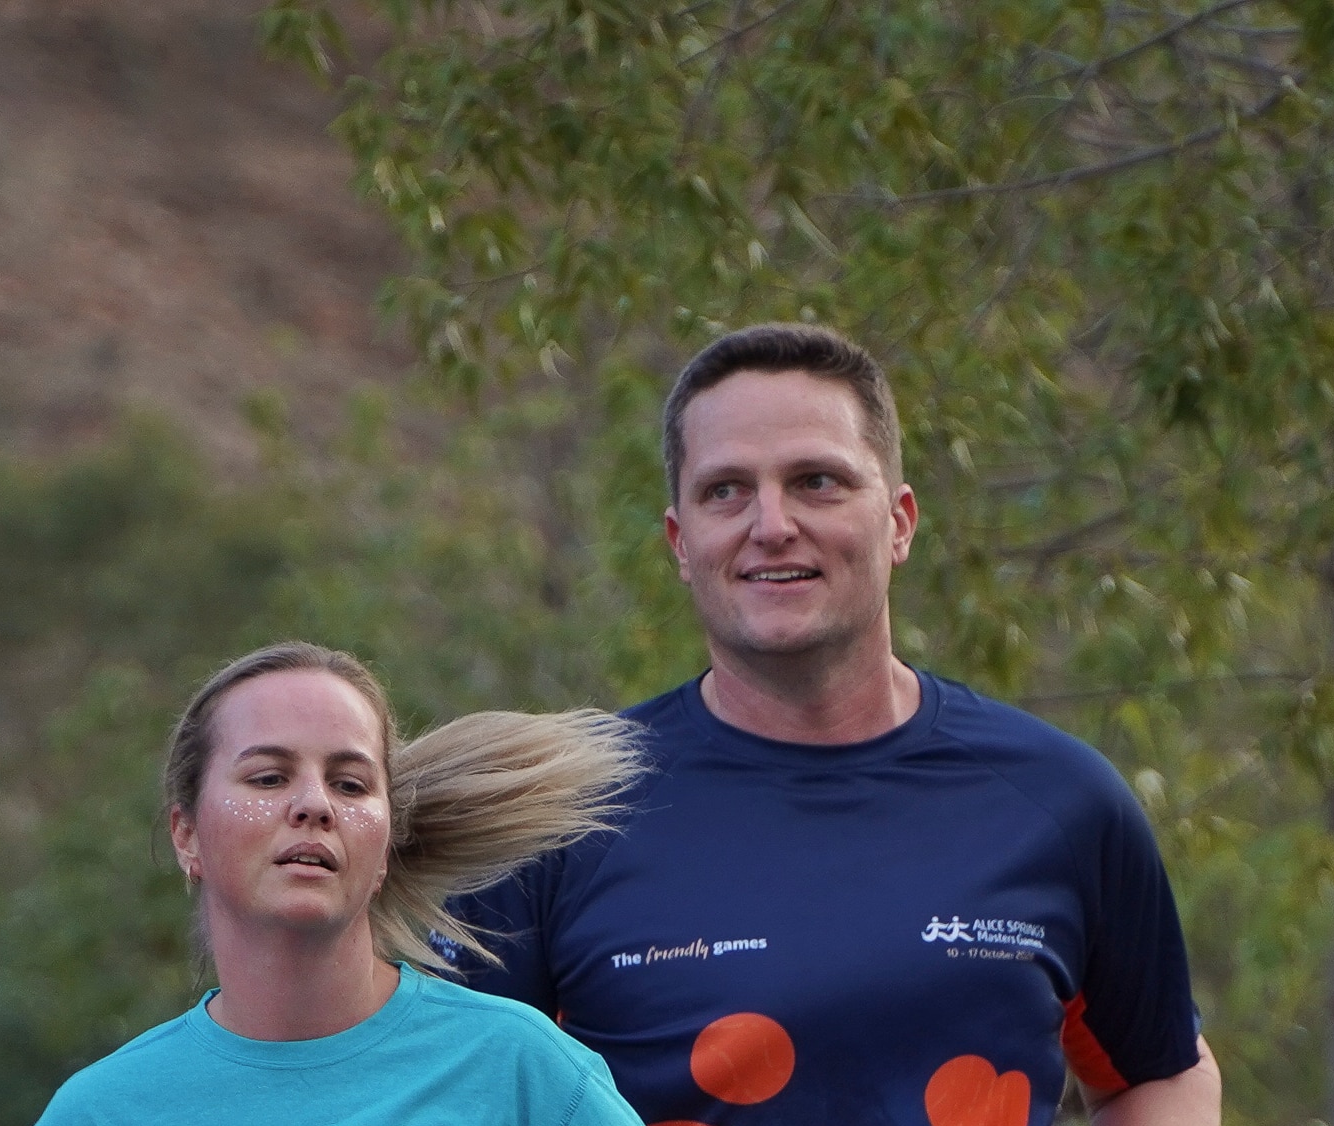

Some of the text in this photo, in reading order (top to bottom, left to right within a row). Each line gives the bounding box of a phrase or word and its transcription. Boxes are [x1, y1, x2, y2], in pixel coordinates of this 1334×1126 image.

[972, 918, 1005, 932] ALICE
[611, 937, 768, 968] The friendly games
[946, 947, 959, 959] 10
